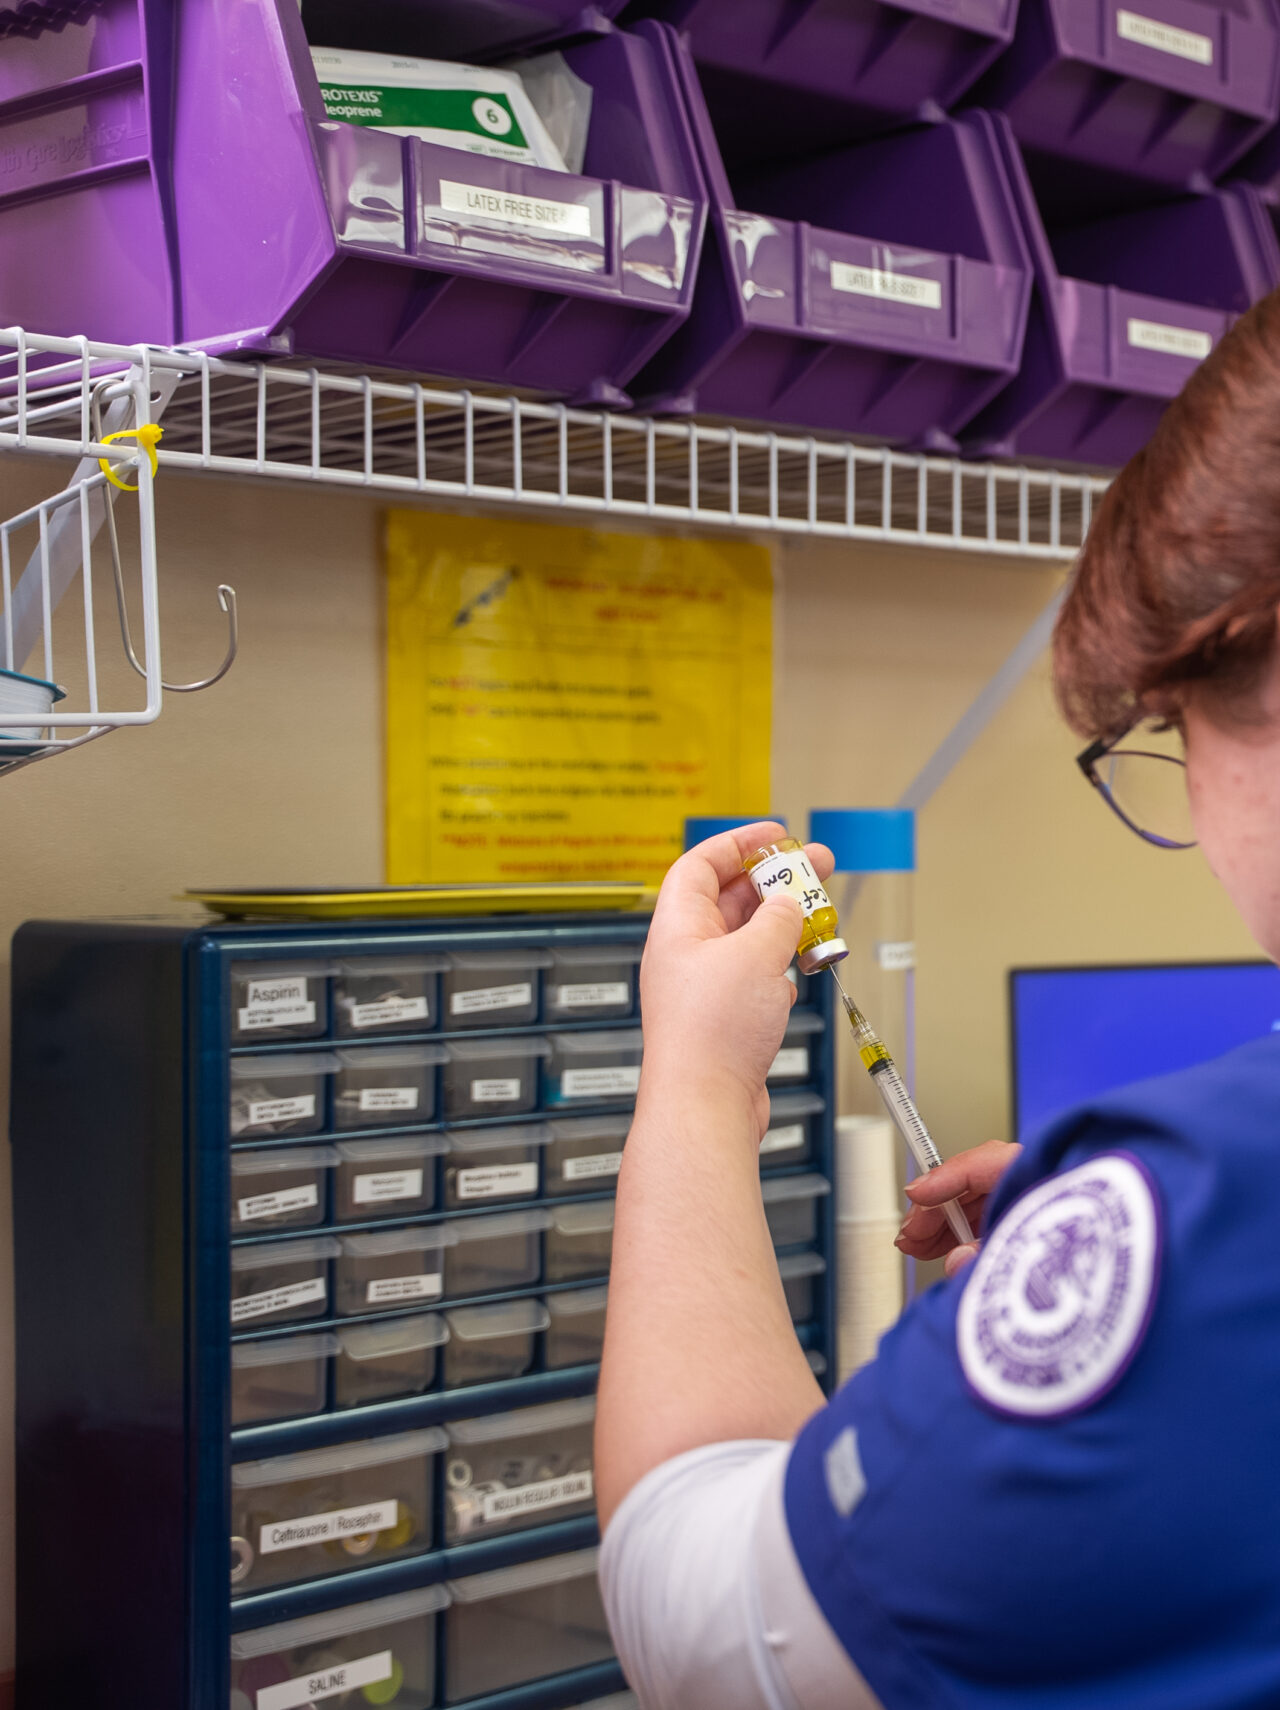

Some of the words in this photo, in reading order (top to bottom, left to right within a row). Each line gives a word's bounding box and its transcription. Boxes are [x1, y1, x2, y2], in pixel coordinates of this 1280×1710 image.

[486, 108, 499, 124] 6
[466, 191, 502, 213] LATEX
[504, 199, 533, 219] FREE
[534, 206, 559, 224] SIZE
[252, 985, 300, 1002] Aspirin
[271, 1521, 329, 1545] Ceftriaxone
[337, 1511, 382, 1530] Rocephin
[308, 1669, 347, 1696] SALINE
